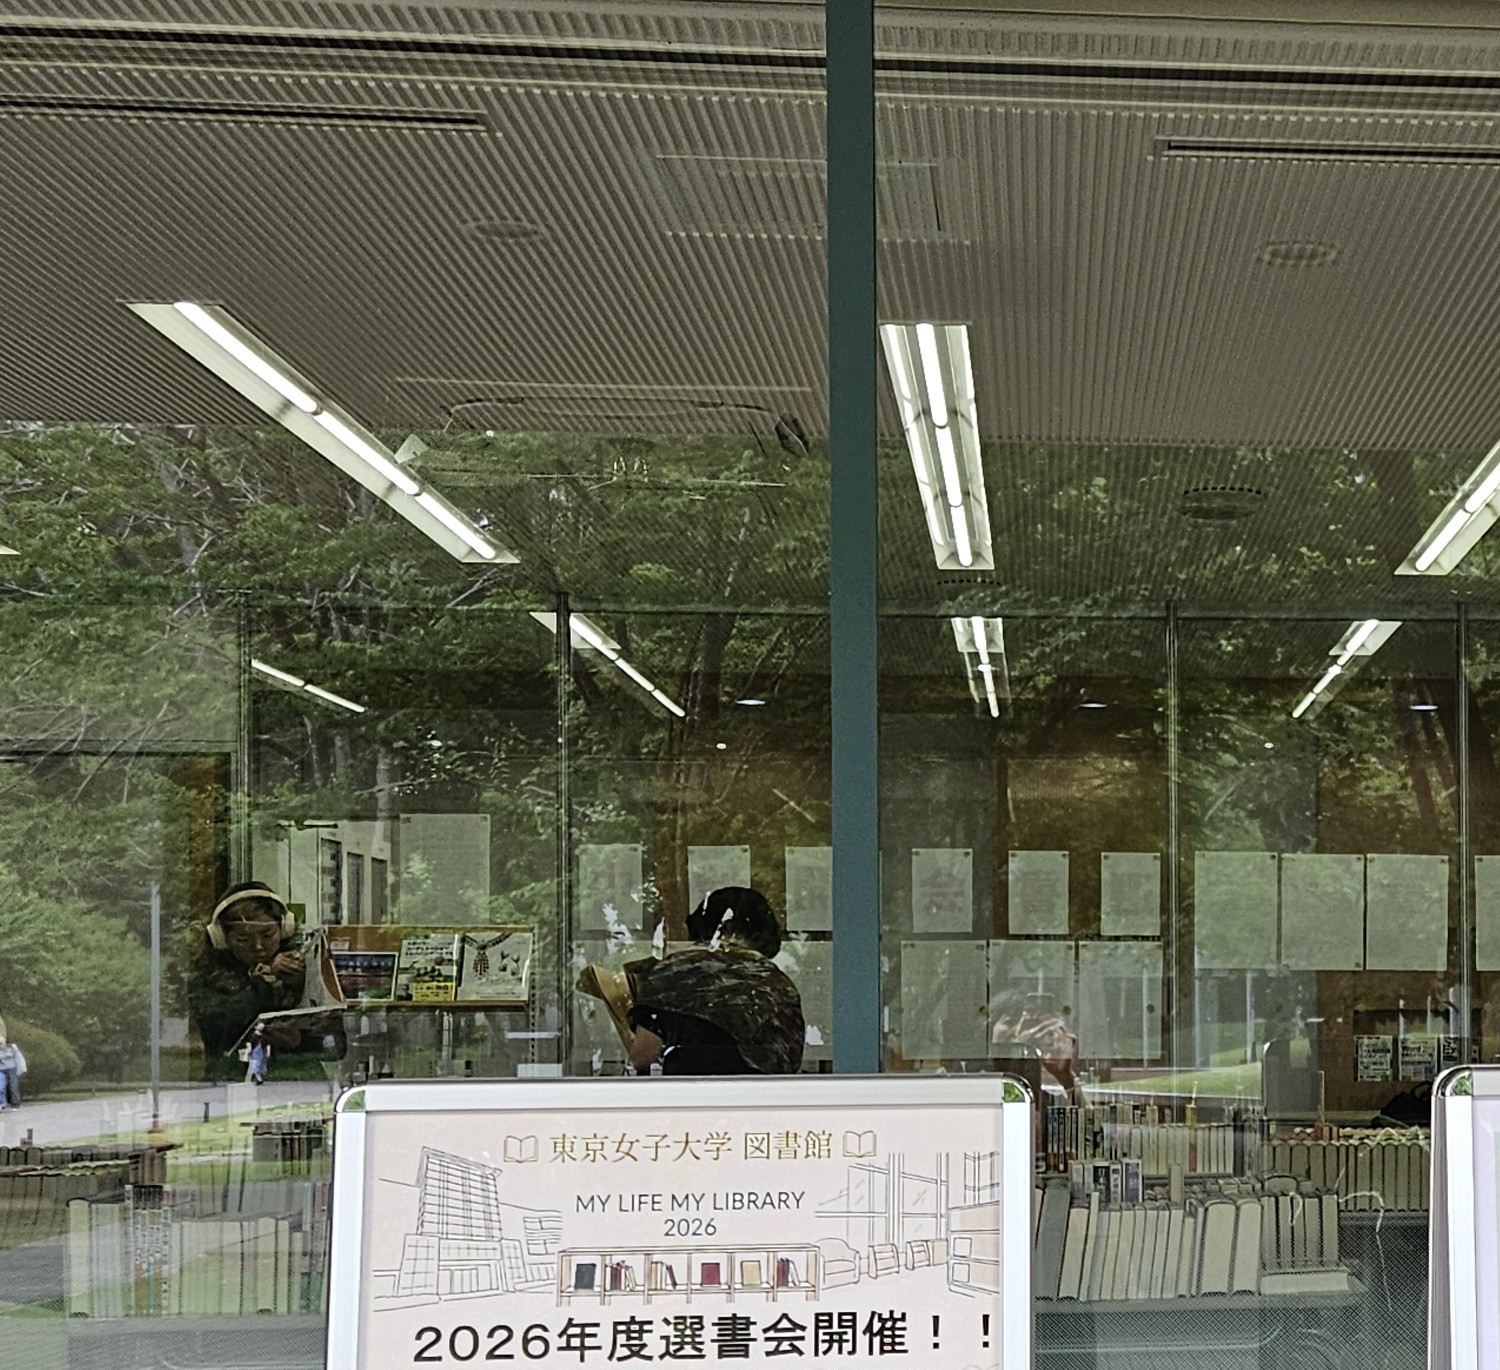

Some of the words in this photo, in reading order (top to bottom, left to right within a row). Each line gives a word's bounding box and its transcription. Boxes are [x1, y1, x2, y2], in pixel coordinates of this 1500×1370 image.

[576, 1193, 612, 1213] MY
[618, 1193, 663, 1213] LIFE
[671, 1192, 706, 1212] MY
[713, 1190, 806, 1211] LIBRARY
[663, 1217, 717, 1237] 2026
[413, 1309, 991, 1363] 2026年度選書会開催！！
